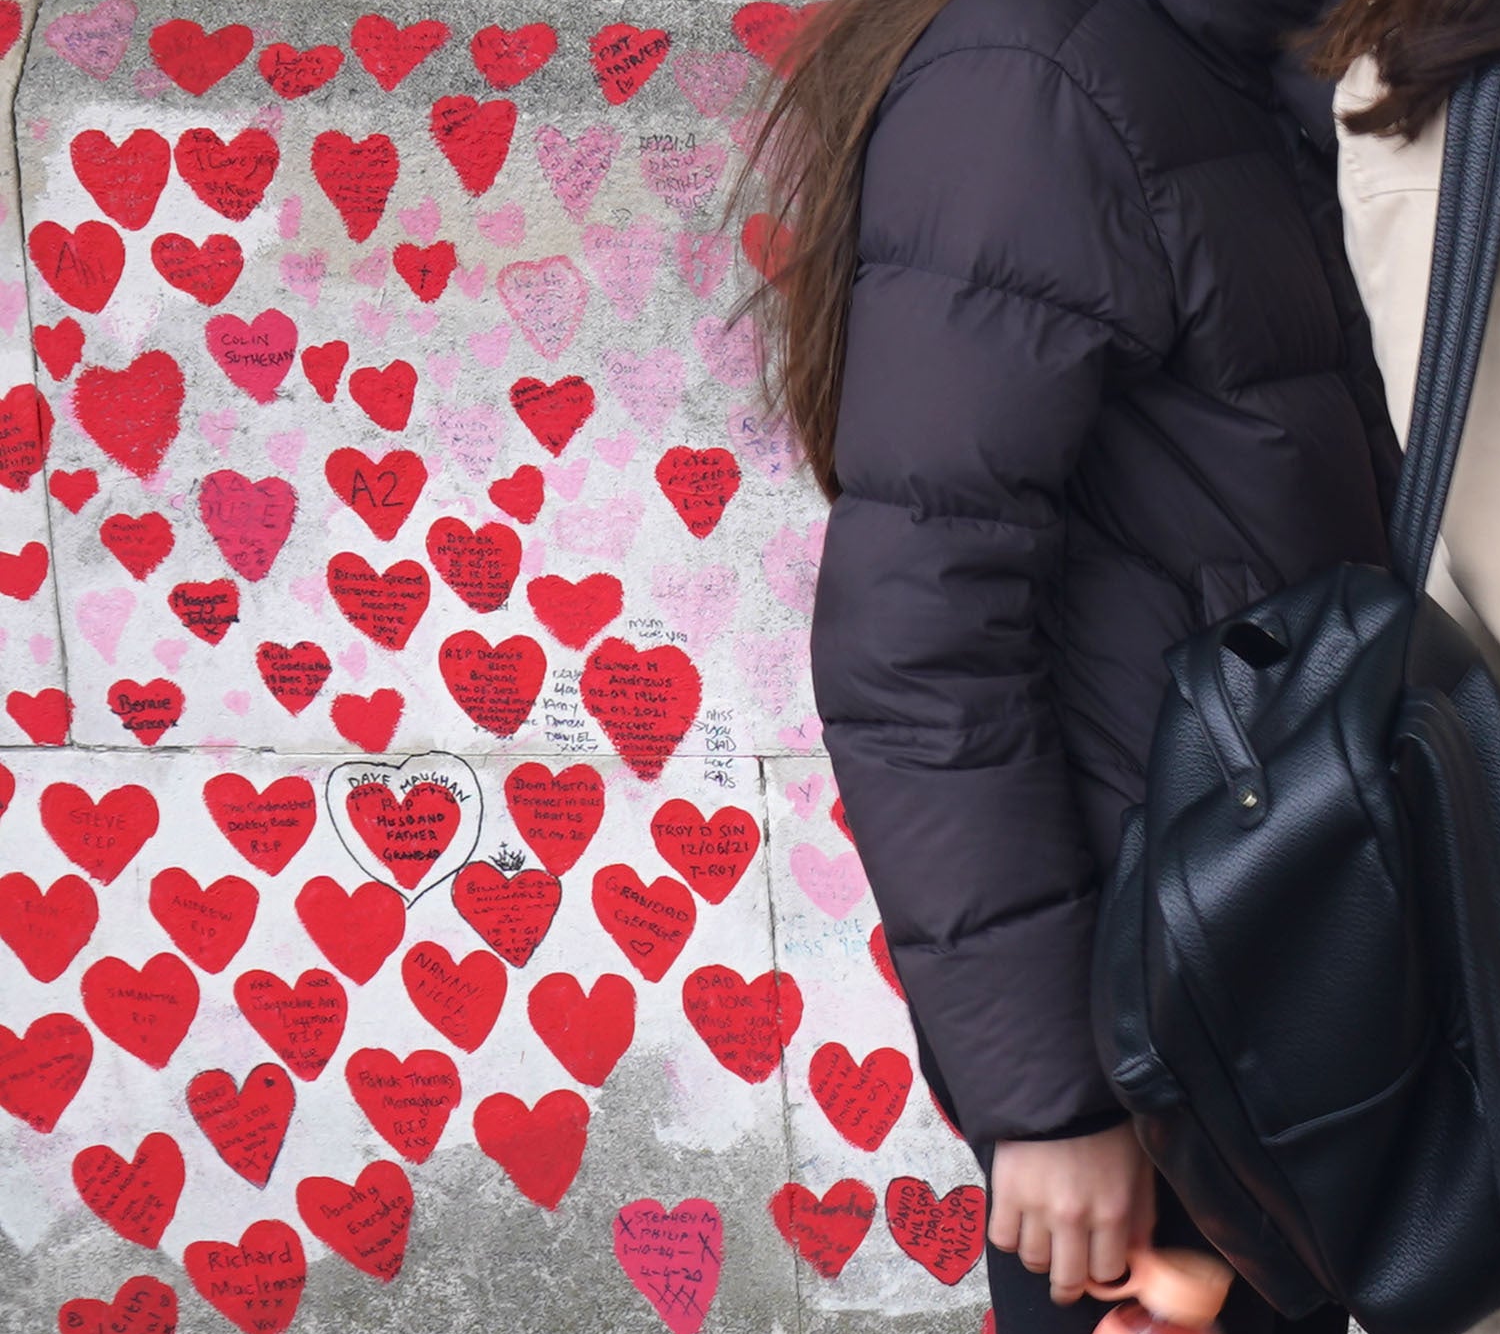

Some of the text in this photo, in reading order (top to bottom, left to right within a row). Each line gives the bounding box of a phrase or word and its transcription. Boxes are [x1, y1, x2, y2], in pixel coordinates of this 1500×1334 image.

[221, 334, 269, 347] COLIN
[351, 469, 403, 509] A2
[348, 772, 470, 803] DAVE MAUGHAN
[655, 824, 693, 837] TROY
[898, 1187, 915, 1230] DAVID
[208, 1242, 293, 1267] Richard
